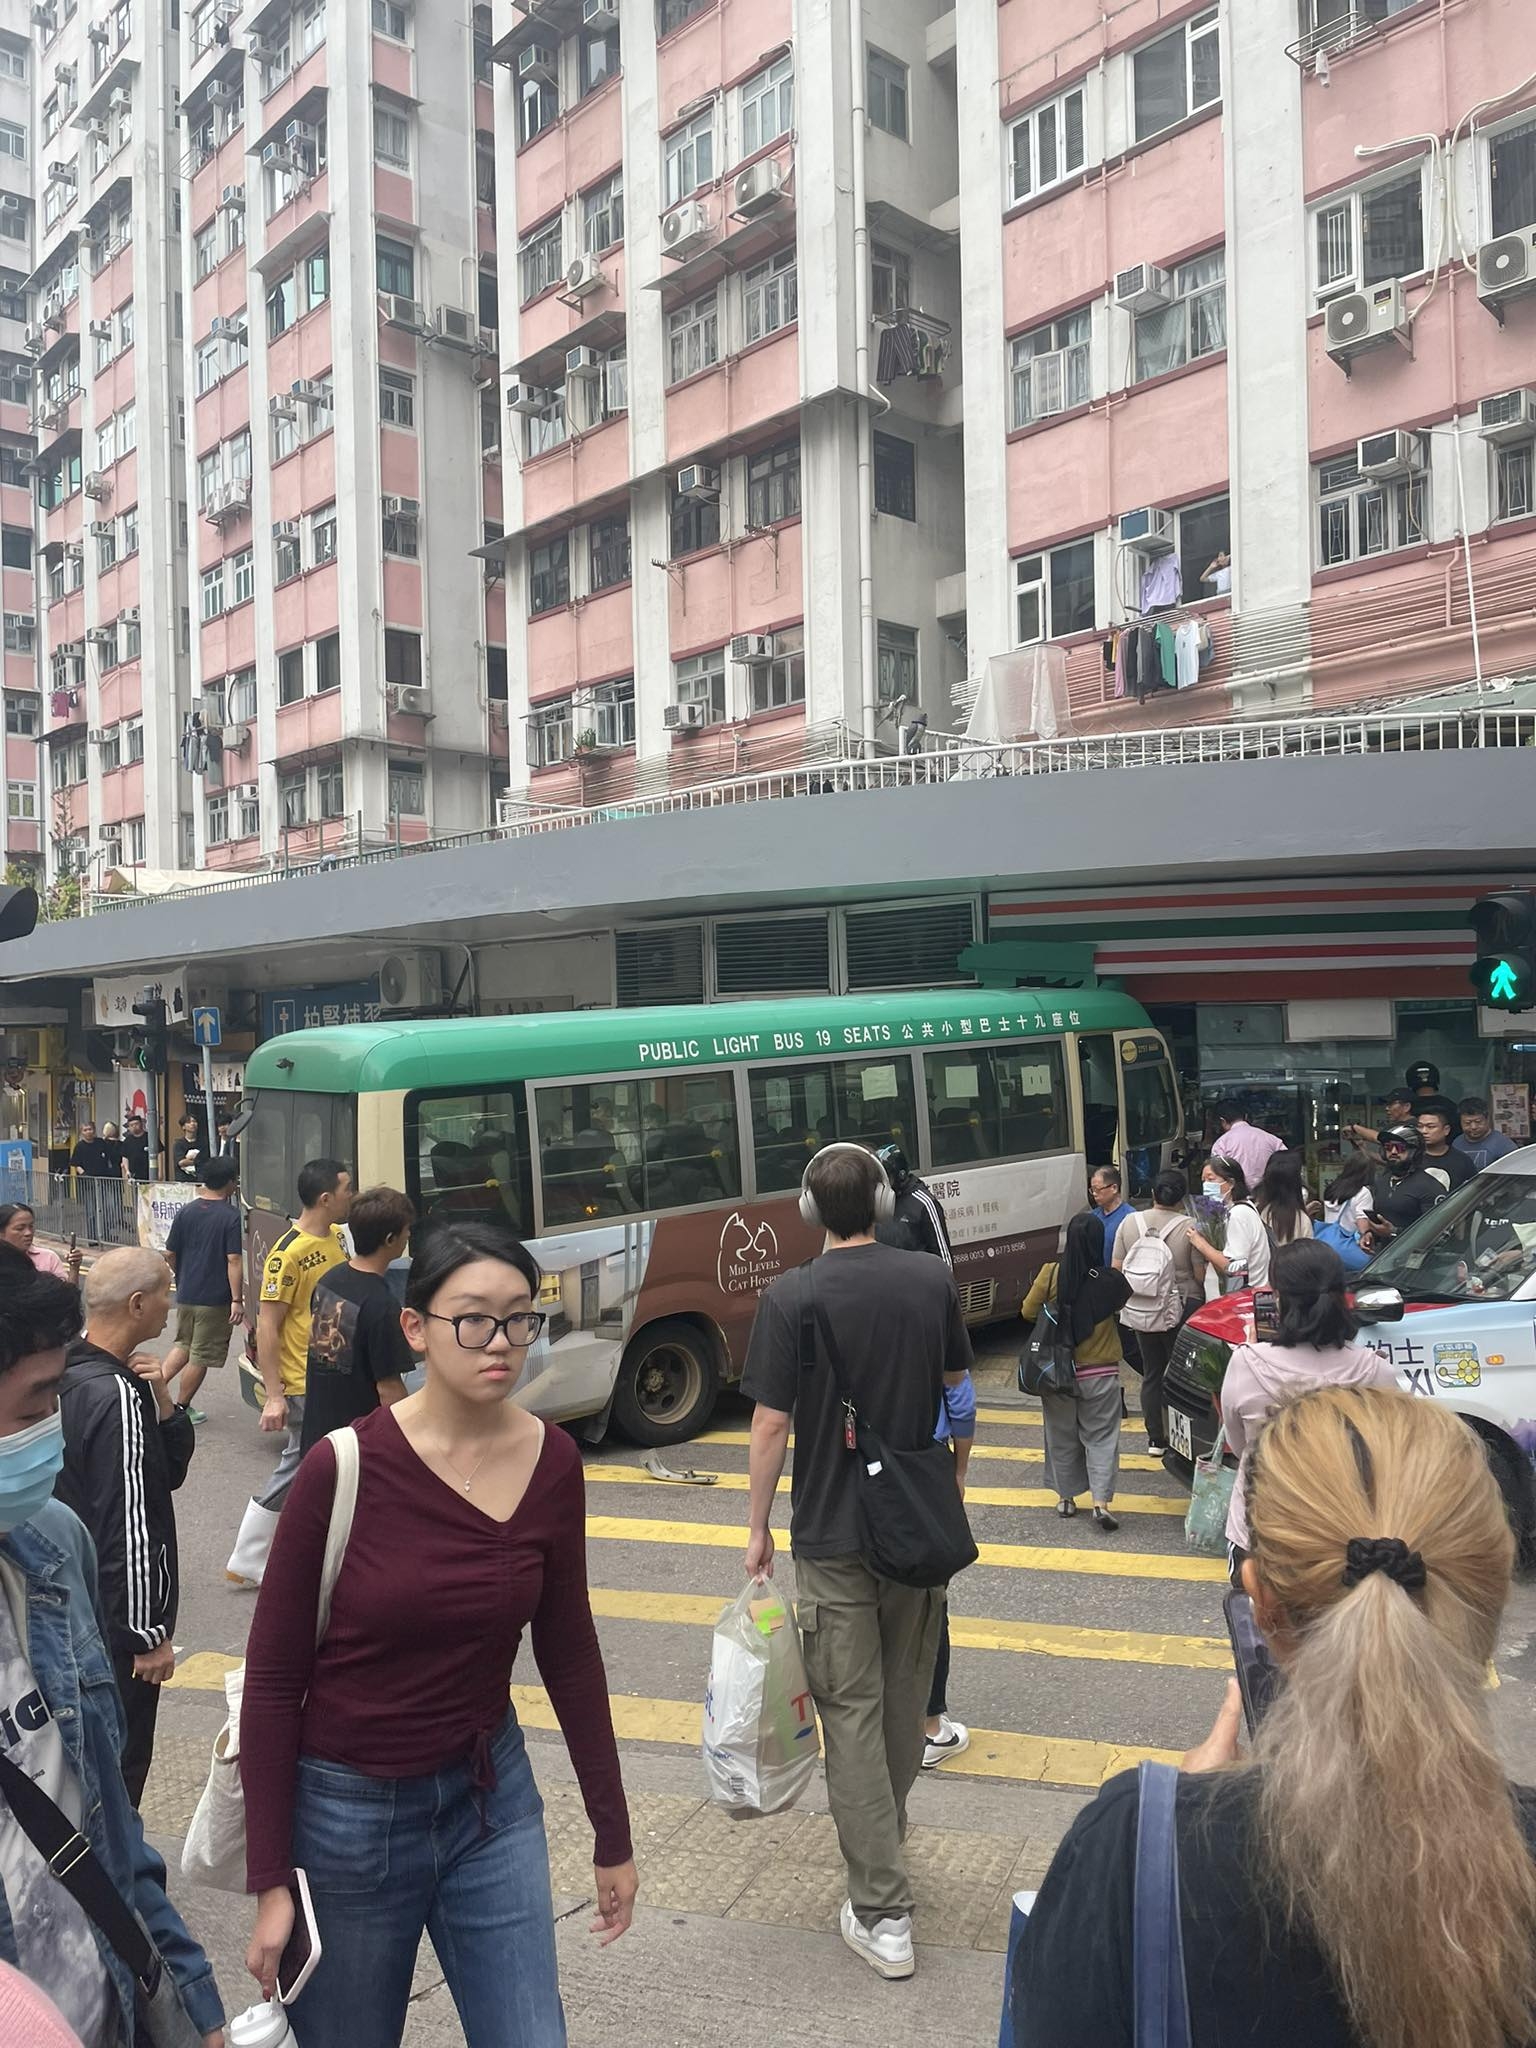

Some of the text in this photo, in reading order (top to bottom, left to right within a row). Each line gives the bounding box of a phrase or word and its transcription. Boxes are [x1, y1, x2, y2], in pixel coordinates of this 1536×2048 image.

[639, 1011, 1081, 1062] PUBLIC LIGHT BUS 19 SEATS 公共小型巴士十九座位
[927, 1180, 961, 1200] 醫院
